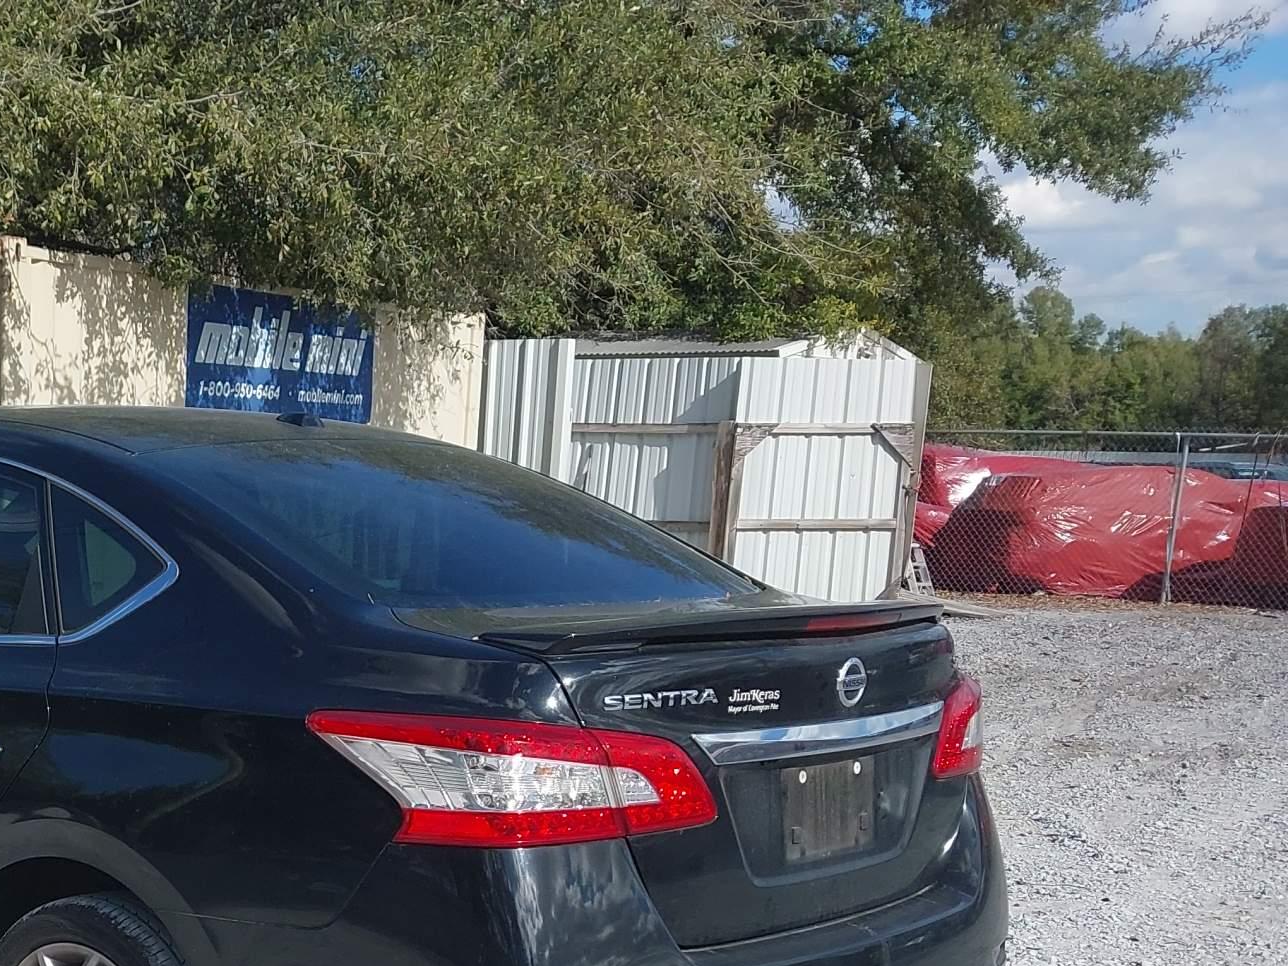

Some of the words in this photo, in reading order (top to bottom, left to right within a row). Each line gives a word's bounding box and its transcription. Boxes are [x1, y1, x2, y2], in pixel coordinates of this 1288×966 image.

[195, 307, 304, 371] mobile
[305, 327, 367, 376] mini
[199, 380, 281, 400] 1-800-950-6464
[603, 688, 719, 711] SENTRA
